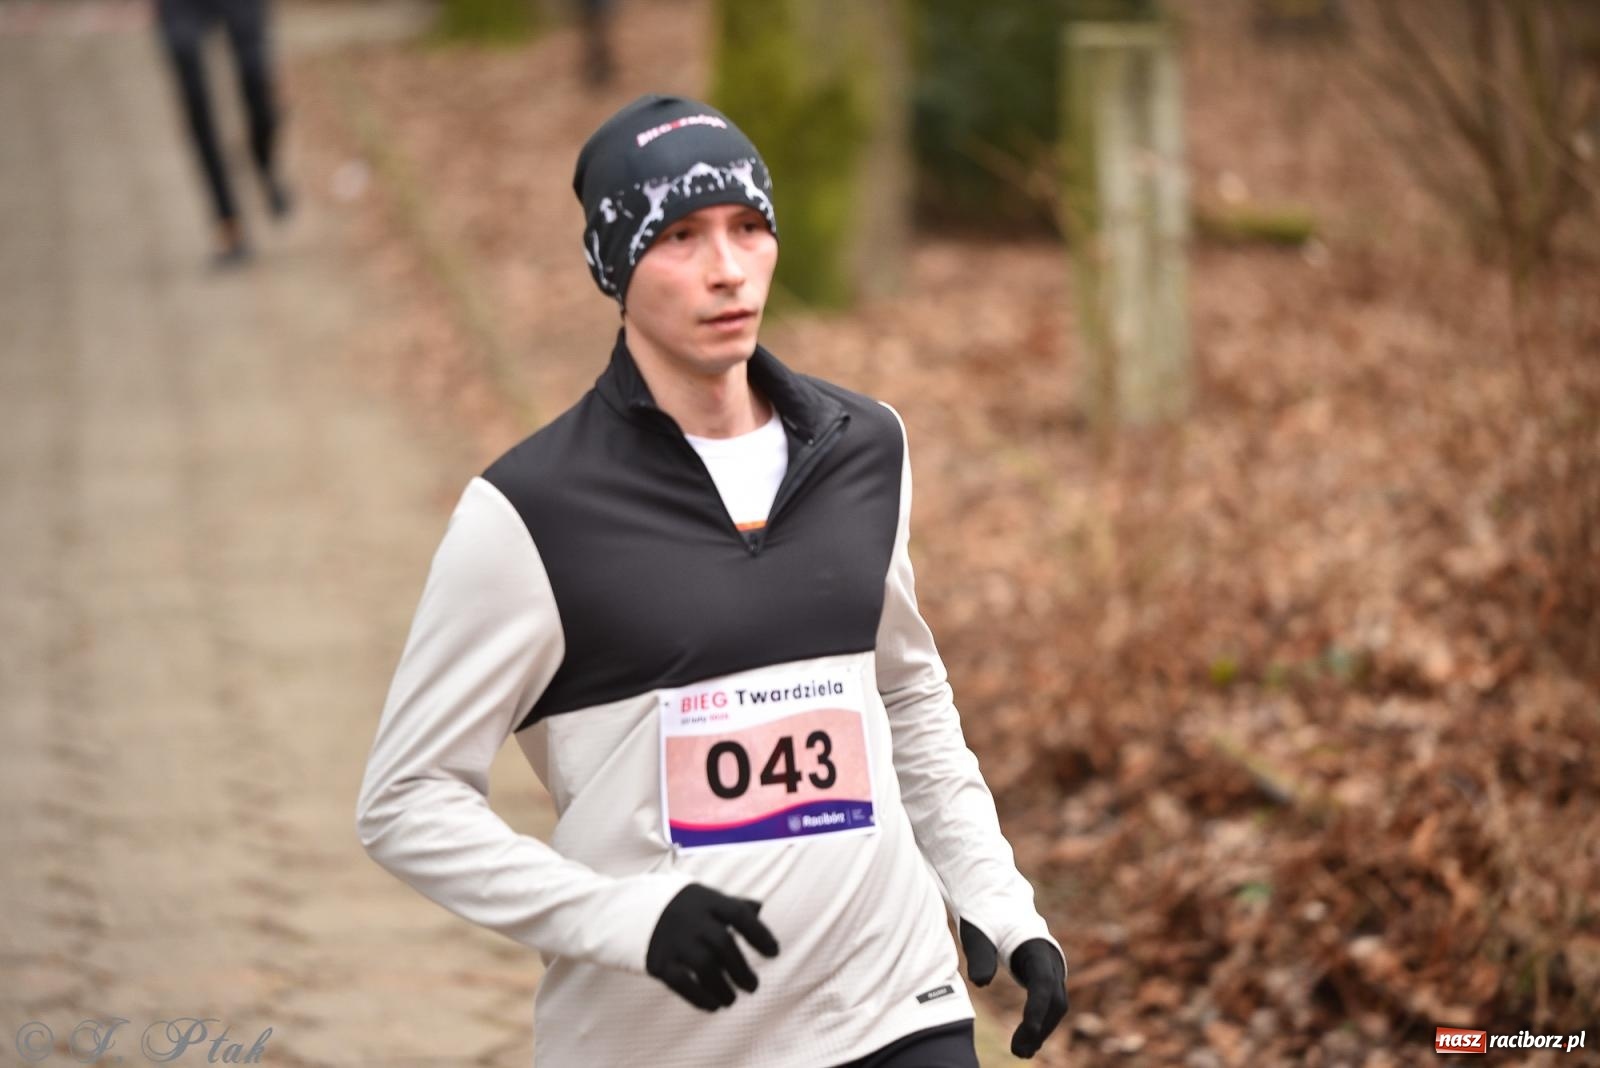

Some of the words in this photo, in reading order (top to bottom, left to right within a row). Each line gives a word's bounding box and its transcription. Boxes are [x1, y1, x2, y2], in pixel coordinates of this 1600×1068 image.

[680, 691, 729, 714] BIEG
[735, 679, 844, 706] Twardziela
[705, 729, 838, 801] 043
